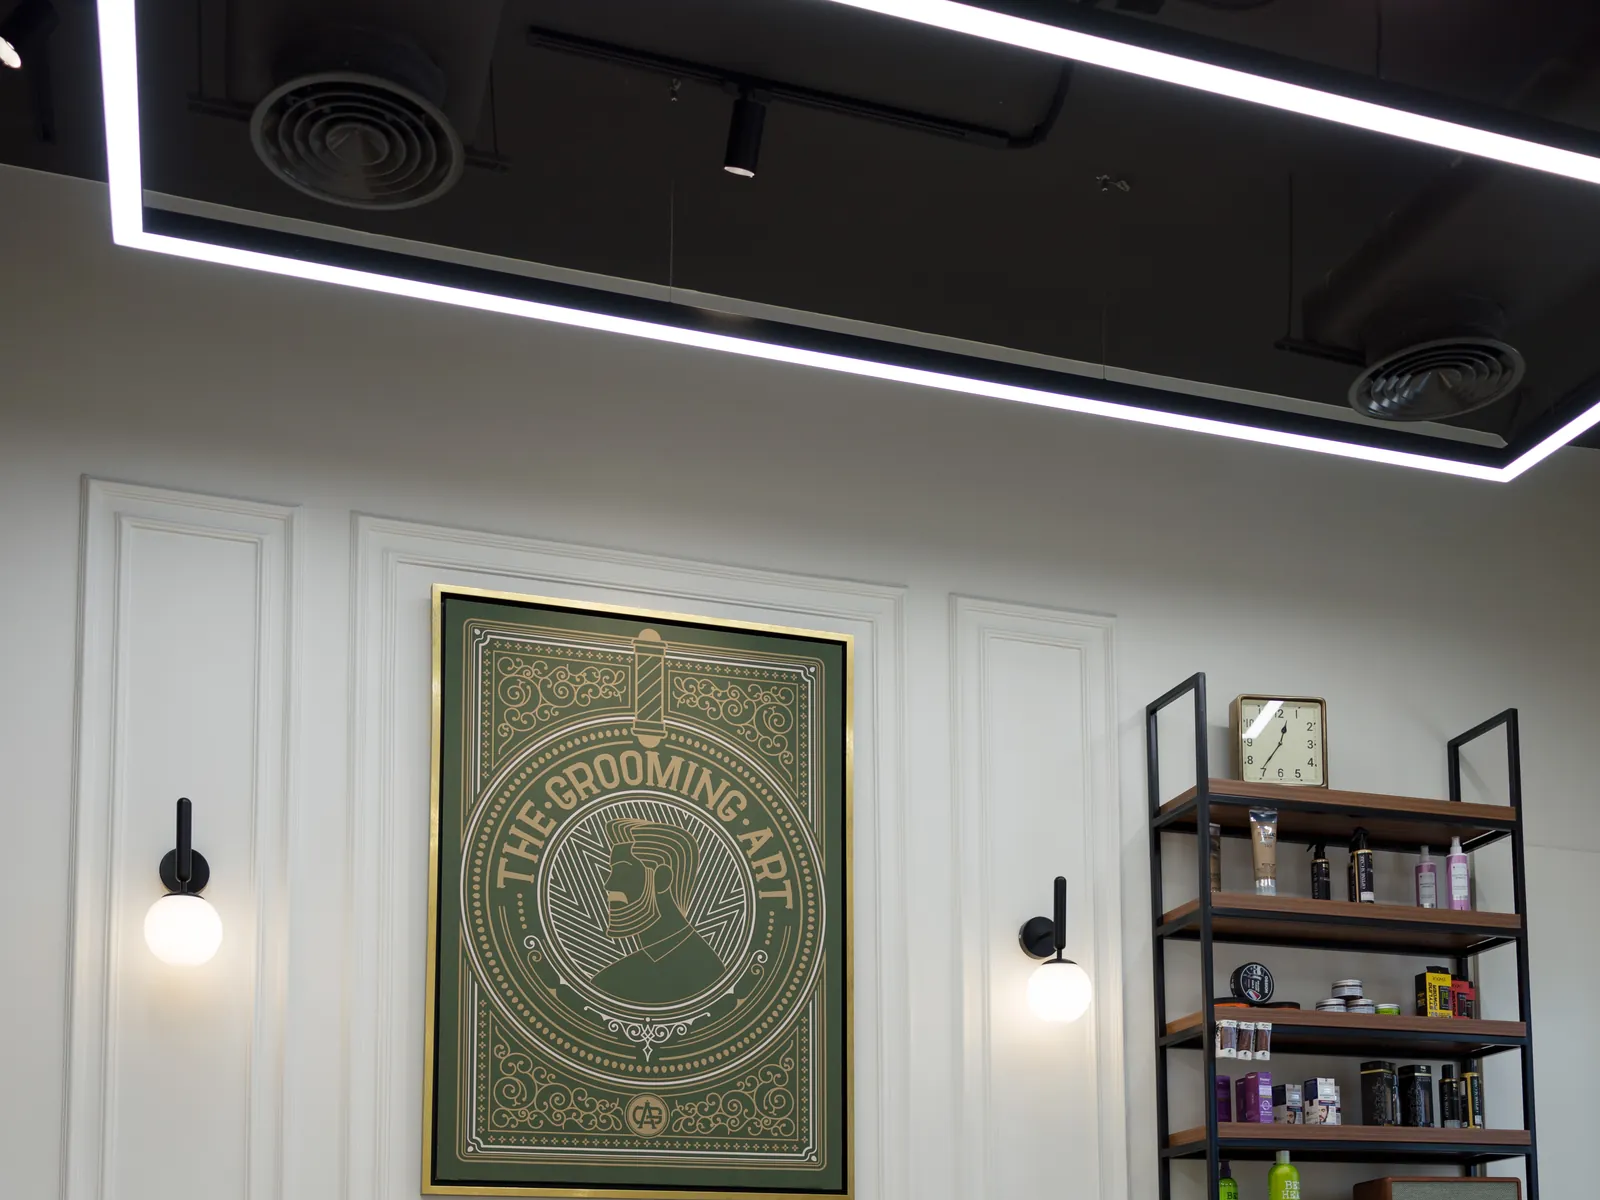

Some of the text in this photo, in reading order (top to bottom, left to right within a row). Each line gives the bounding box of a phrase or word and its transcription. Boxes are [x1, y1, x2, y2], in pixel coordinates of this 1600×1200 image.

[1306, 722, 1313, 732] 2
[1246, 738, 1253, 747] 9
[1307, 740, 1314, 749] 3
[1247, 755, 1254, 765] 8
[1307, 758, 1314, 767] 4
[1260, 767, 1267, 777] 7
[1277, 768, 1284, 778] 6
[1294, 769, 1301, 778] 5
[497, 750, 793, 909] THE GROOMING ART
